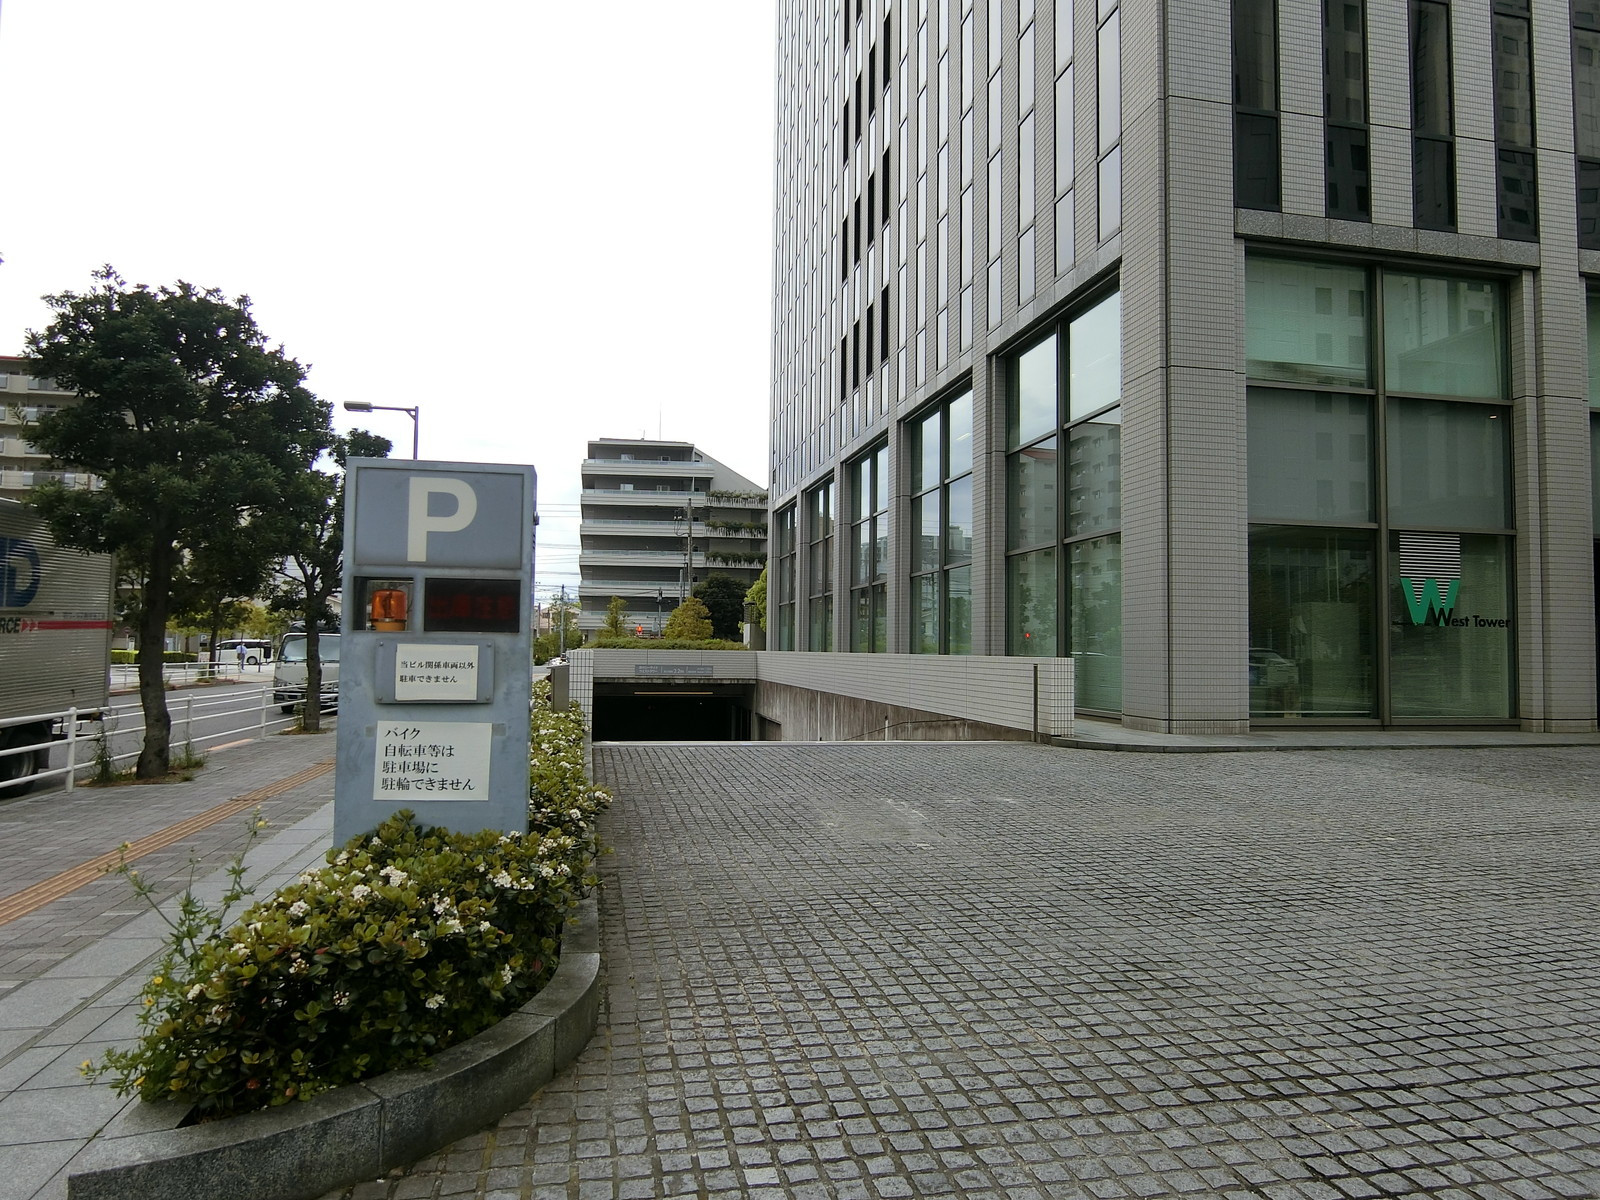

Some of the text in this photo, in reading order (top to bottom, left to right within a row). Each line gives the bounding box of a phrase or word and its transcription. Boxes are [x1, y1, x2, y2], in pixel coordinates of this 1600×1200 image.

[407, 476, 477, 562] P
[1431, 607, 1511, 628] West Tower
[400, 660, 475, 670] 当ビル関係車両以外
[399, 674, 458, 683] 駐車できません
[384, 727, 421, 740] バイク
[384, 743, 455, 758] 自転車等は
[382, 760, 439, 774] 駐車場に
[381, 777, 476, 791] 駐輪できません
